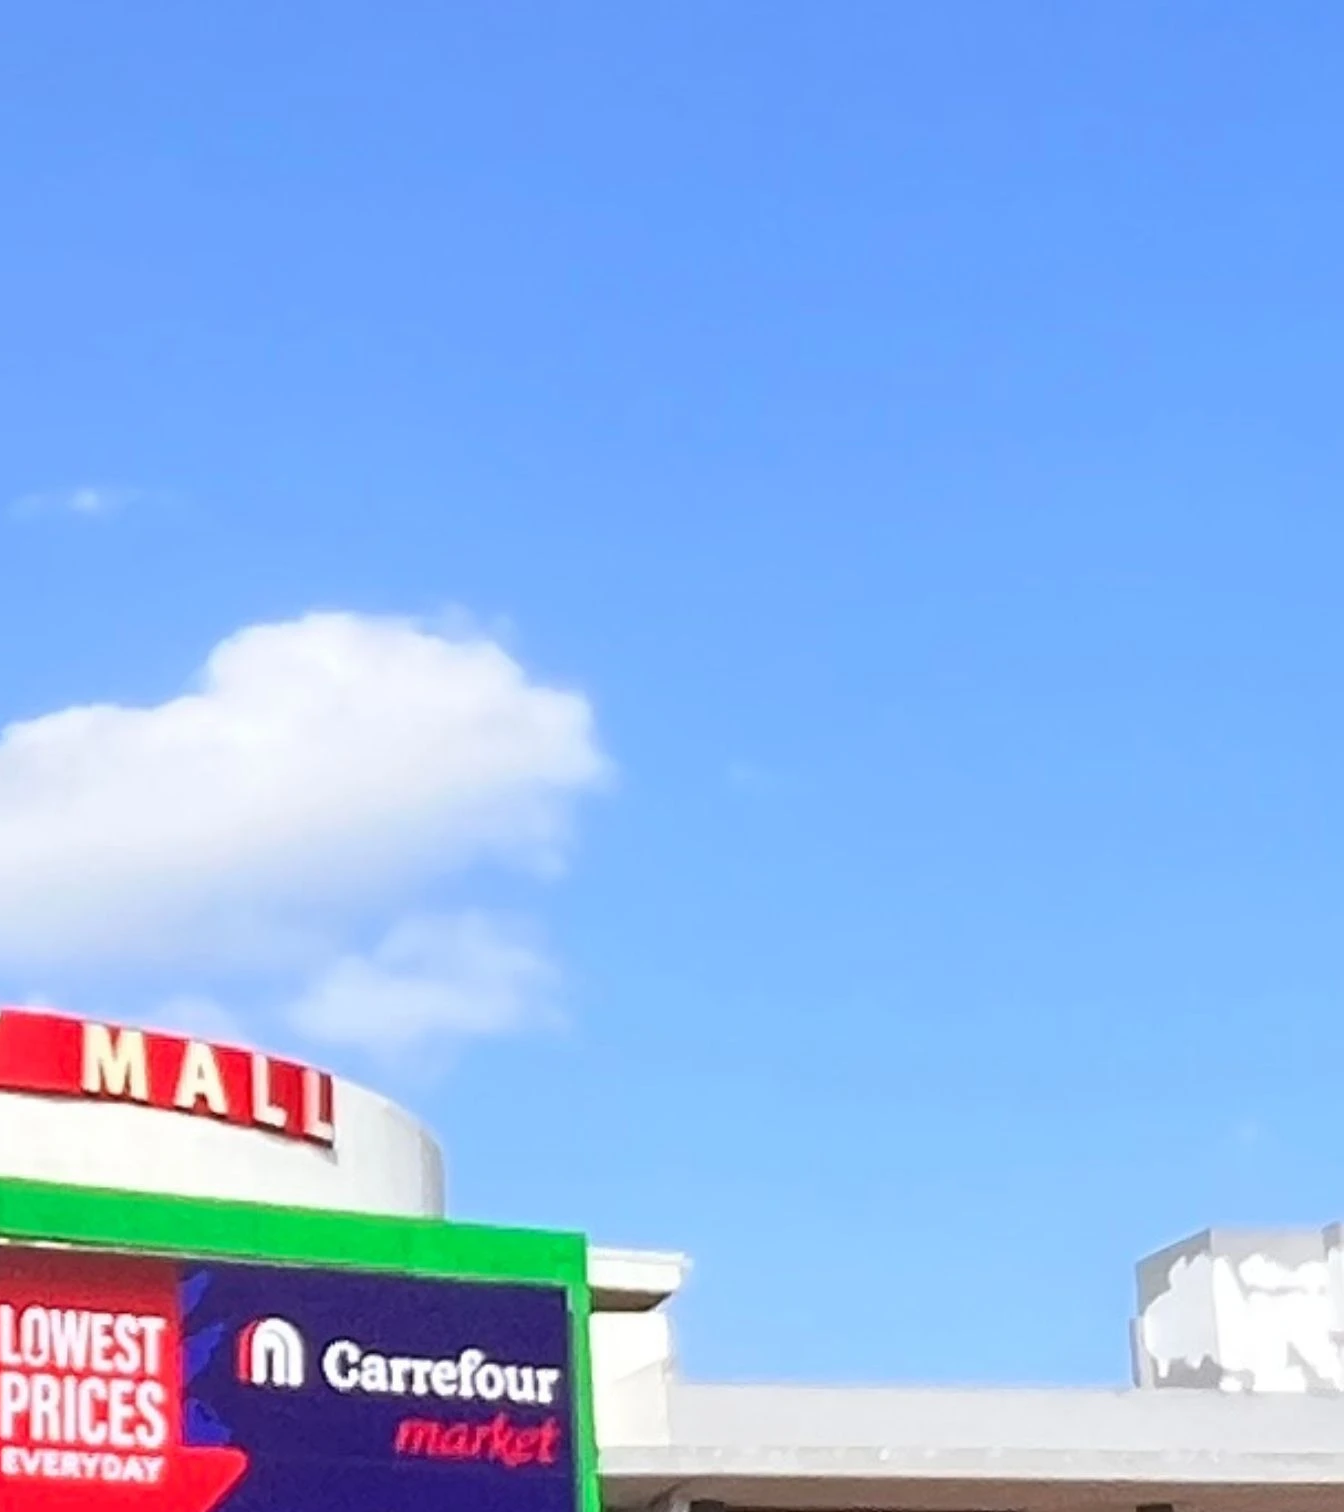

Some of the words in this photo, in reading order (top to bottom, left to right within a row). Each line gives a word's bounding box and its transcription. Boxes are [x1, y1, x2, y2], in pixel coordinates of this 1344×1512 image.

[79, 1022, 335, 1141] MALL
[322, 1339, 560, 1405] Carrefour
[0, 1447, 165, 1484] EVERYDAY
[393, 1413, 559, 1468] market
